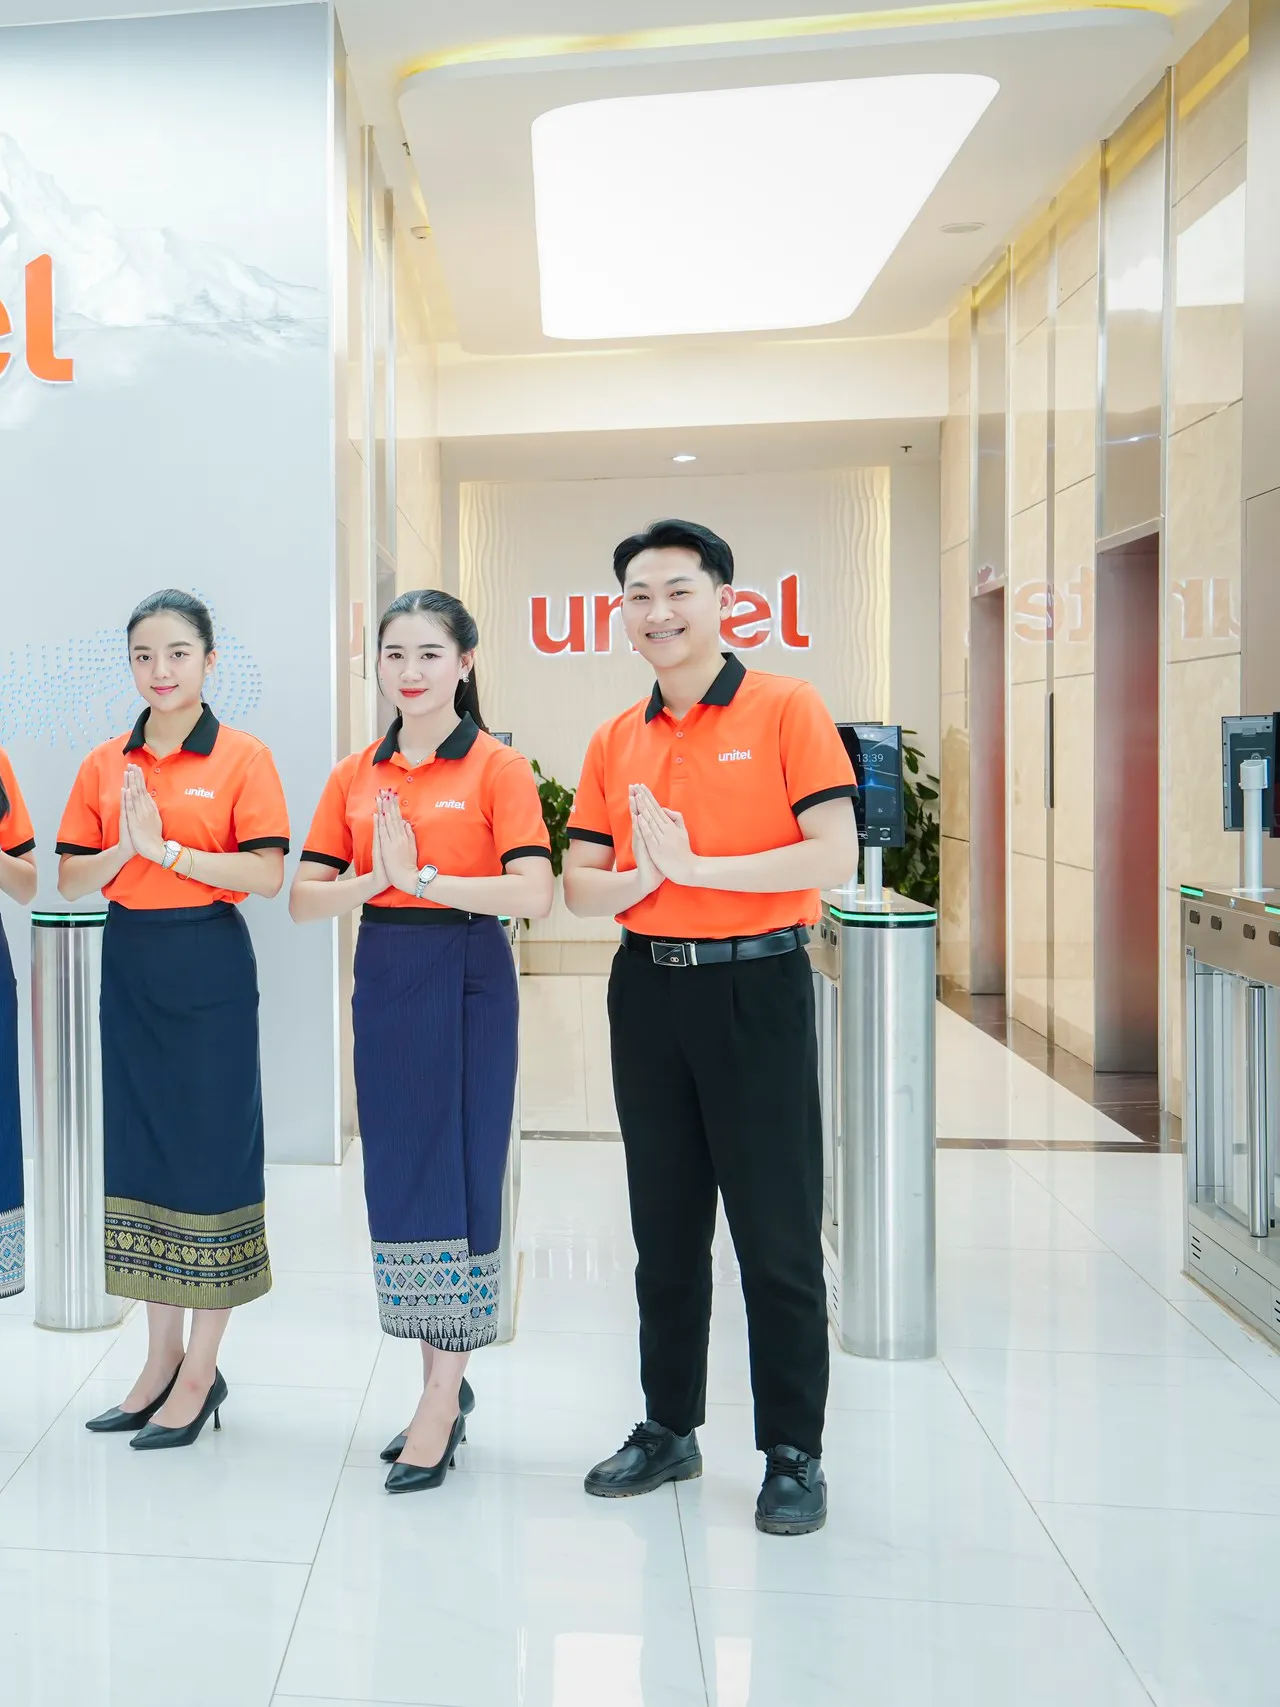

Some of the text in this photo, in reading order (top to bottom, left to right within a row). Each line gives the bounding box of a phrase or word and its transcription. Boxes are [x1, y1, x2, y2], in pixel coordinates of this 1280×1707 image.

[530, 575, 810, 654] unel
[718, 749, 752, 761] unitel
[857, 753, 884, 763] 13:39
[184, 787, 215, 799] unitel
[435, 799, 466, 810] unitel
